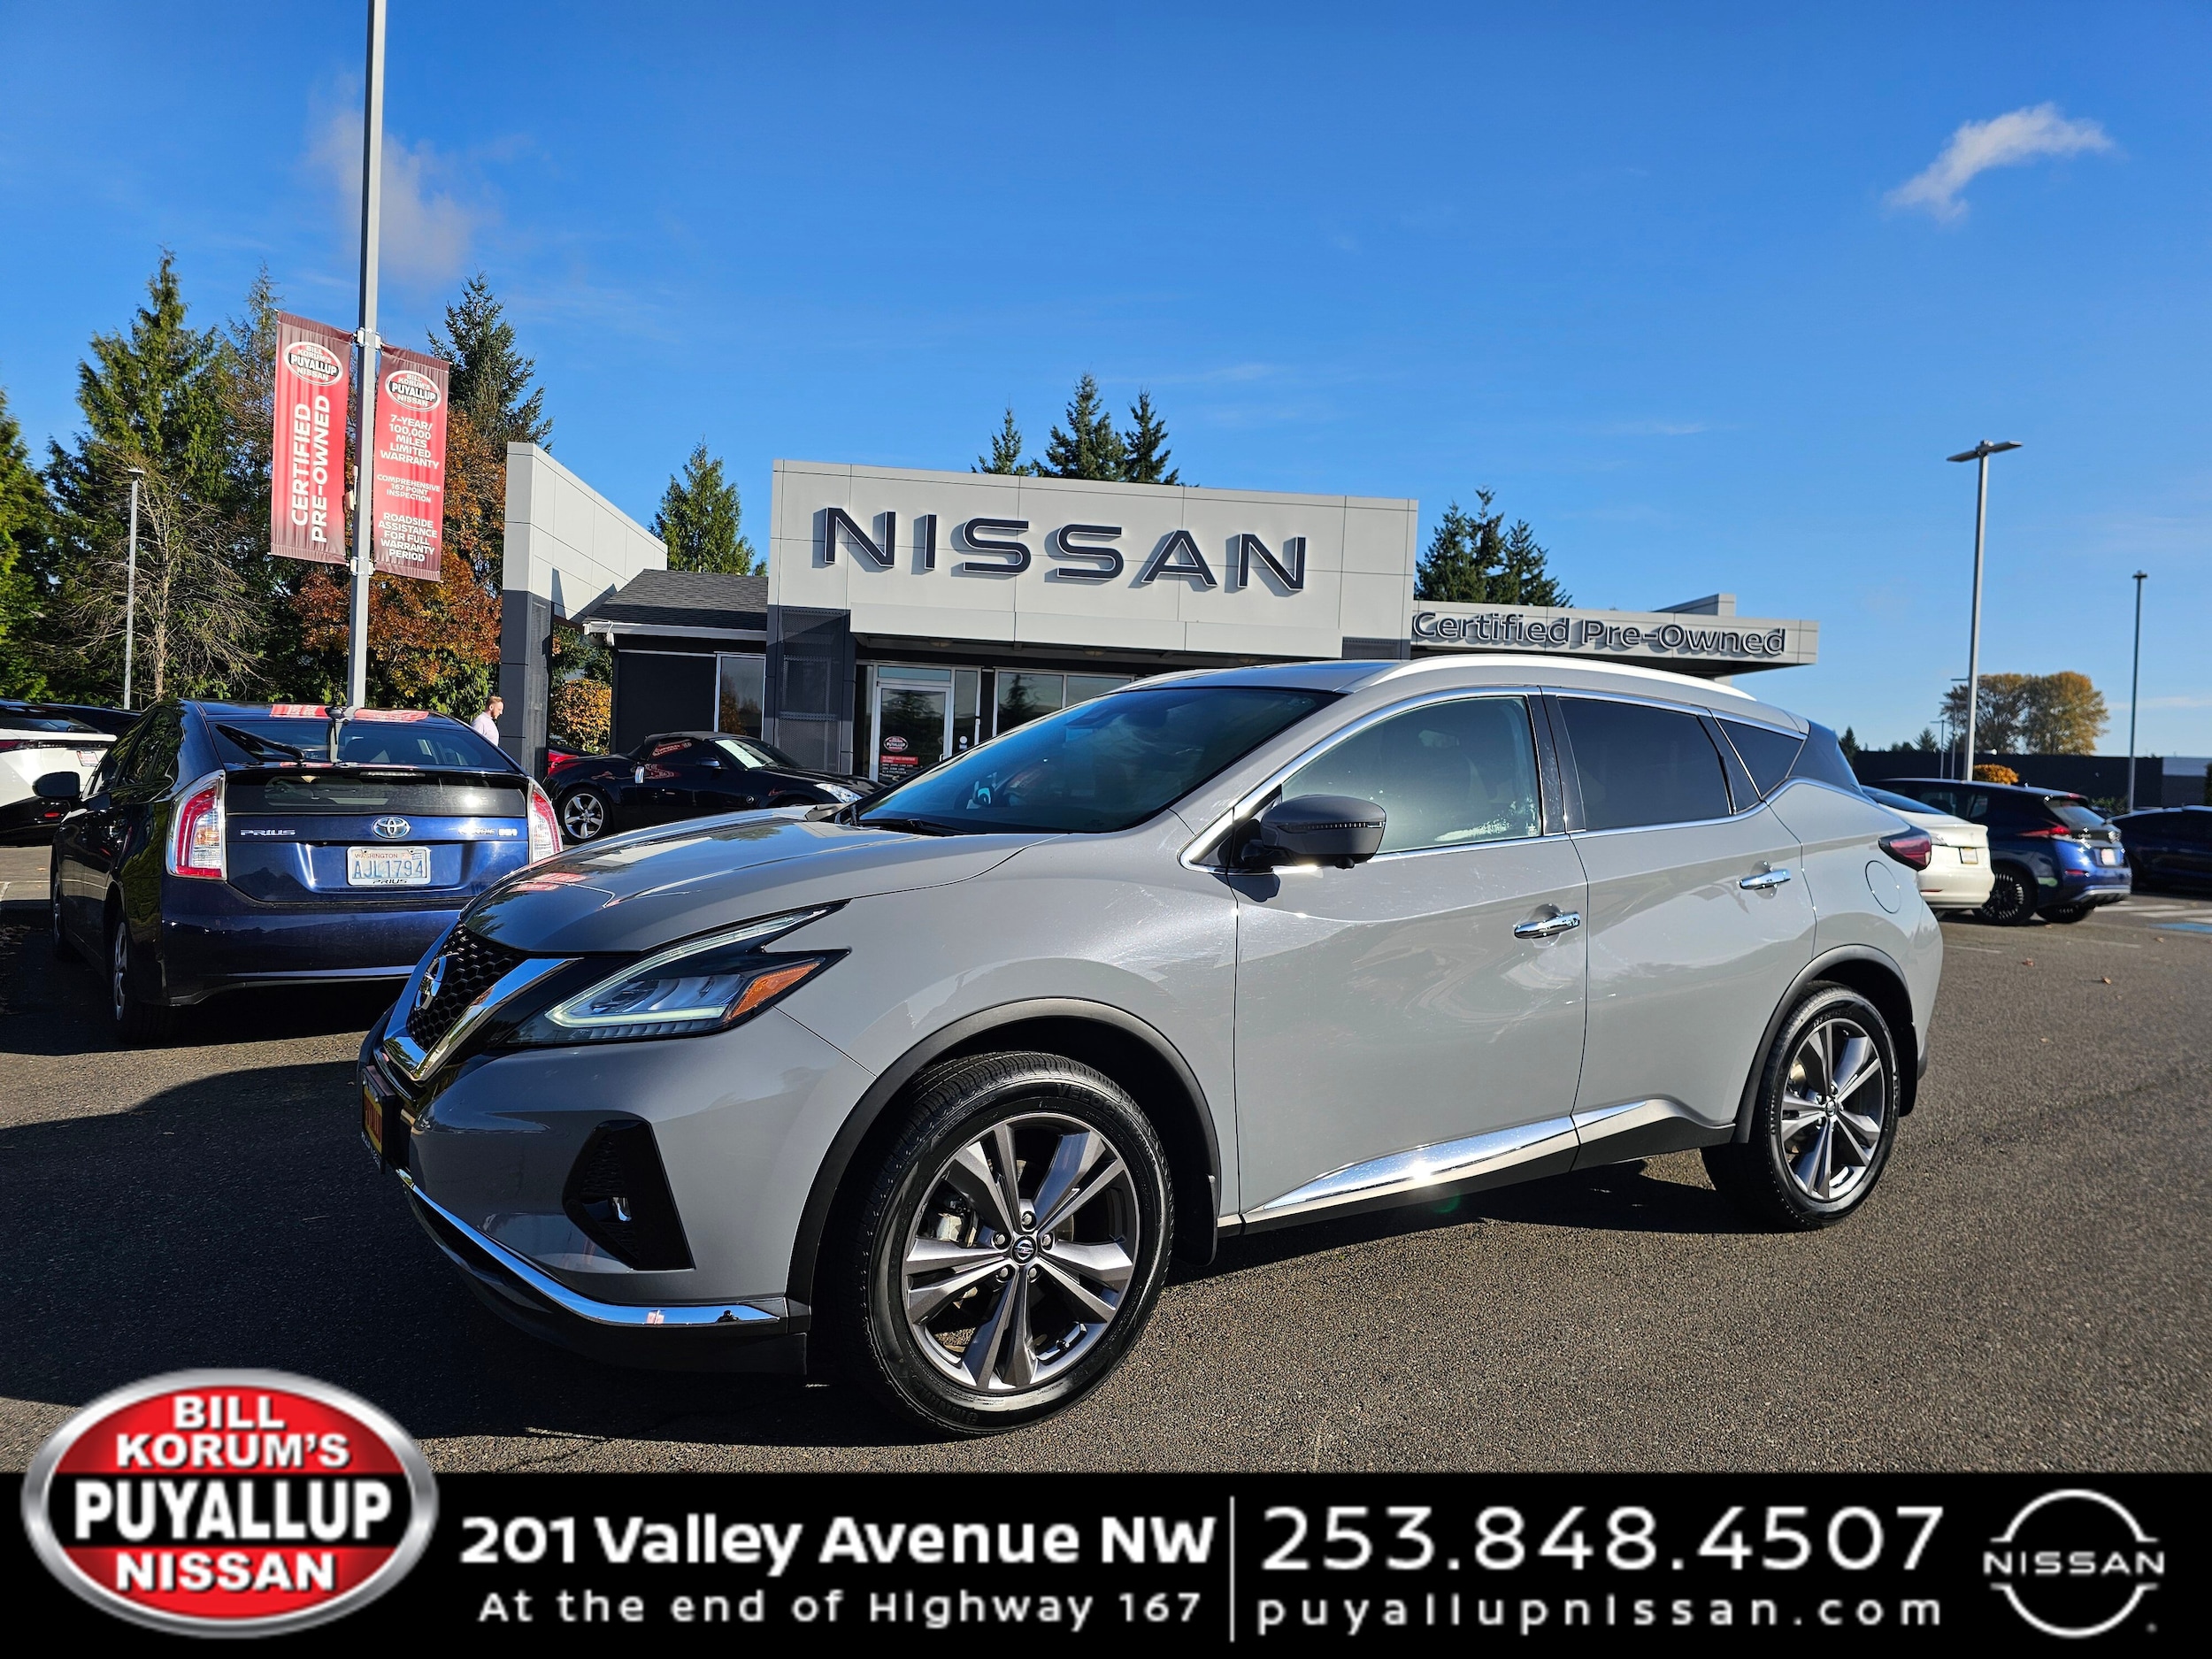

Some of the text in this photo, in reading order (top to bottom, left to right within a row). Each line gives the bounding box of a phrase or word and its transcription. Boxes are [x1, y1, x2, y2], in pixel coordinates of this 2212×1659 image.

[297, 349, 332, 363] KORUM'S
[306, 345, 323, 355] BILL
[290, 354, 337, 375] PUYALLUP
[296, 366, 329, 381] NISSAN
[406, 373, 422, 382] BILL
[398, 377, 431, 390] KORUM'S
[392, 382, 435, 402] PUYALLUP
[397, 394, 428, 407] NISSAN
[390, 414, 433, 432] 7-YEAR/
[389, 424, 431, 440] 100,000
[396, 434, 426, 448] MILES
[390, 442, 431, 458] LIMITED
[291, 403, 311, 526] CERTIFIED
[380, 449, 439, 470] WARRANTY
[311, 395, 330, 543] PRE-OWNED
[377, 474, 441, 492] COMPREHENSIVE
[405, 486, 428, 495] POINT
[387, 489, 431, 503] INSPECTION
[383, 512, 434, 528] ROADSIDE
[378, 520, 437, 538] ASSISTANCE
[384, 531, 430, 545] FOR FULL
[380, 538, 434, 555] WARRANTY
[822, 506, 1307, 592] NISSAN
[389, 549, 425, 562] PERIOD
[1413, 611, 1786, 655] Certified Pre-Owned
[354, 860, 423, 878] AJL1794
